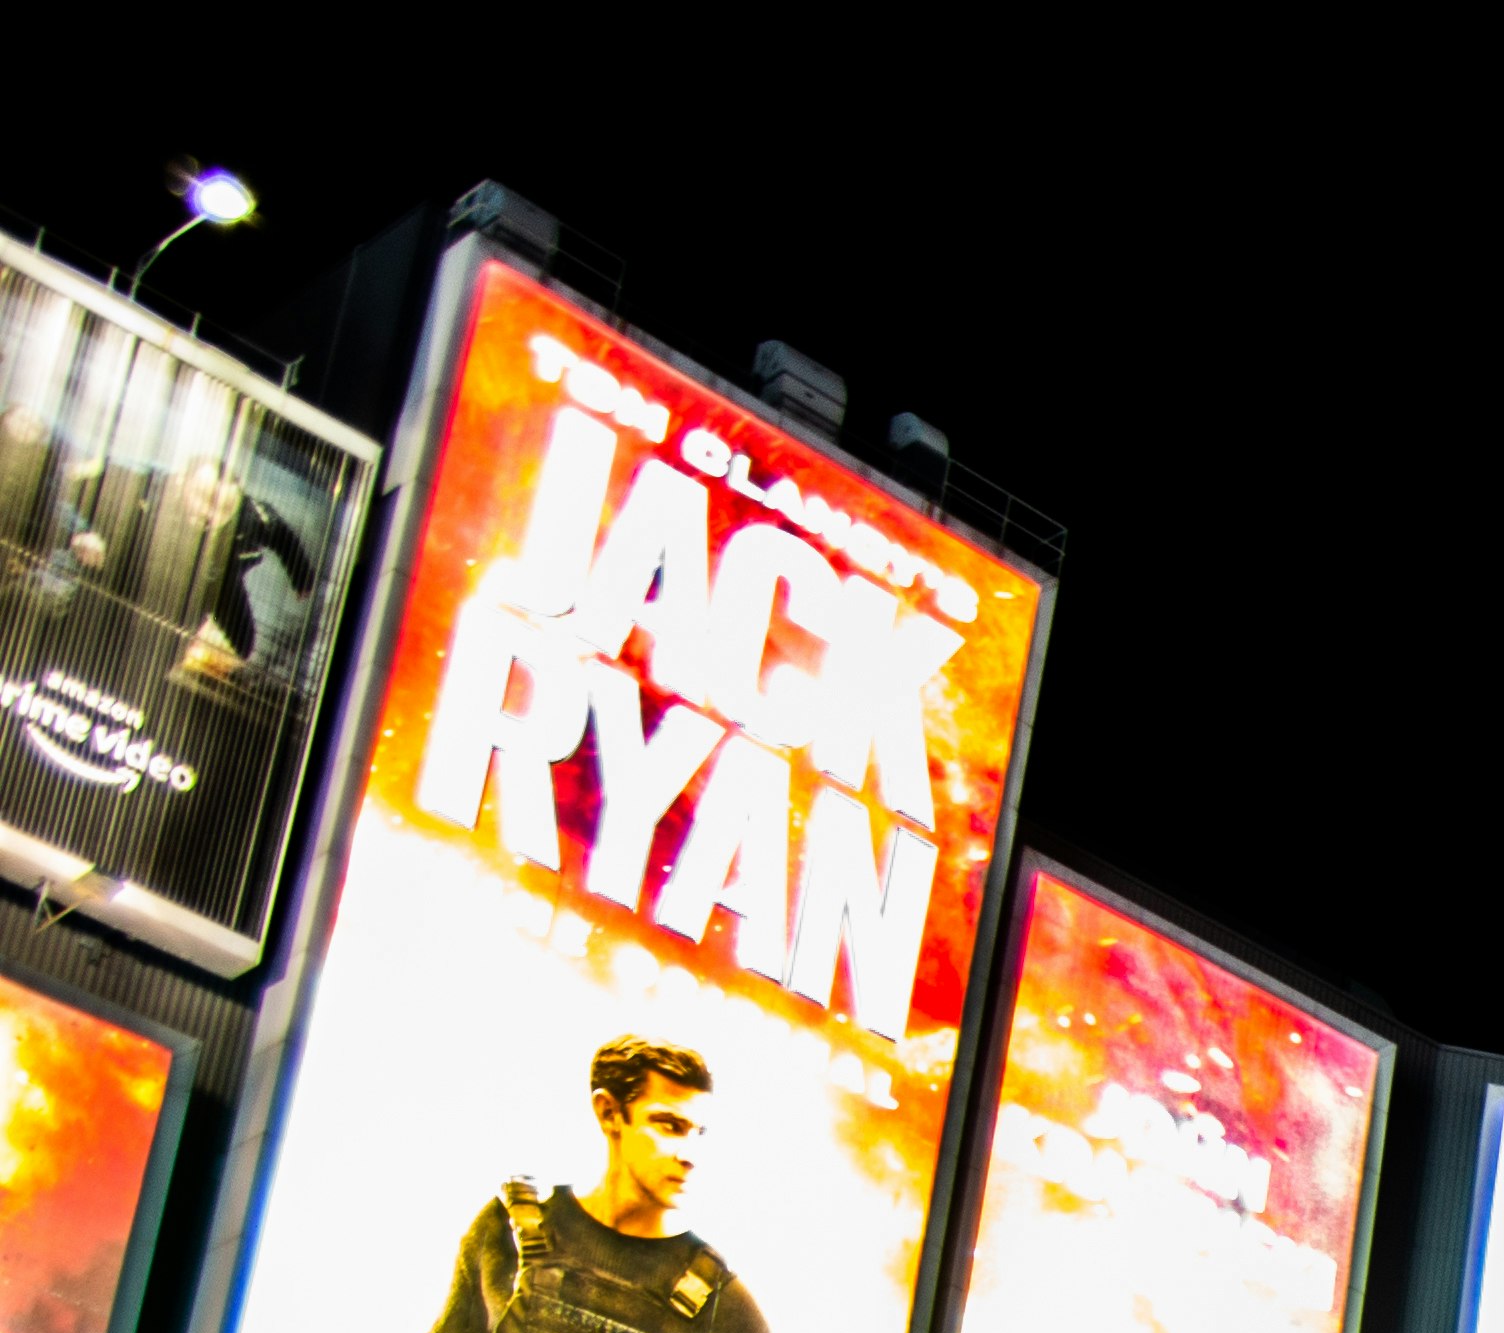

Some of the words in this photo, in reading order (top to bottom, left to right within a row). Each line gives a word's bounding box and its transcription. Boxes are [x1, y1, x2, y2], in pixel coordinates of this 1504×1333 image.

[0, 680, 91, 743] rime
[94, 724, 197, 793] video
[47, 671, 144, 730] amazon
[472, 405, 967, 833] JACK
[415, 590, 940, 1044] RYAN
